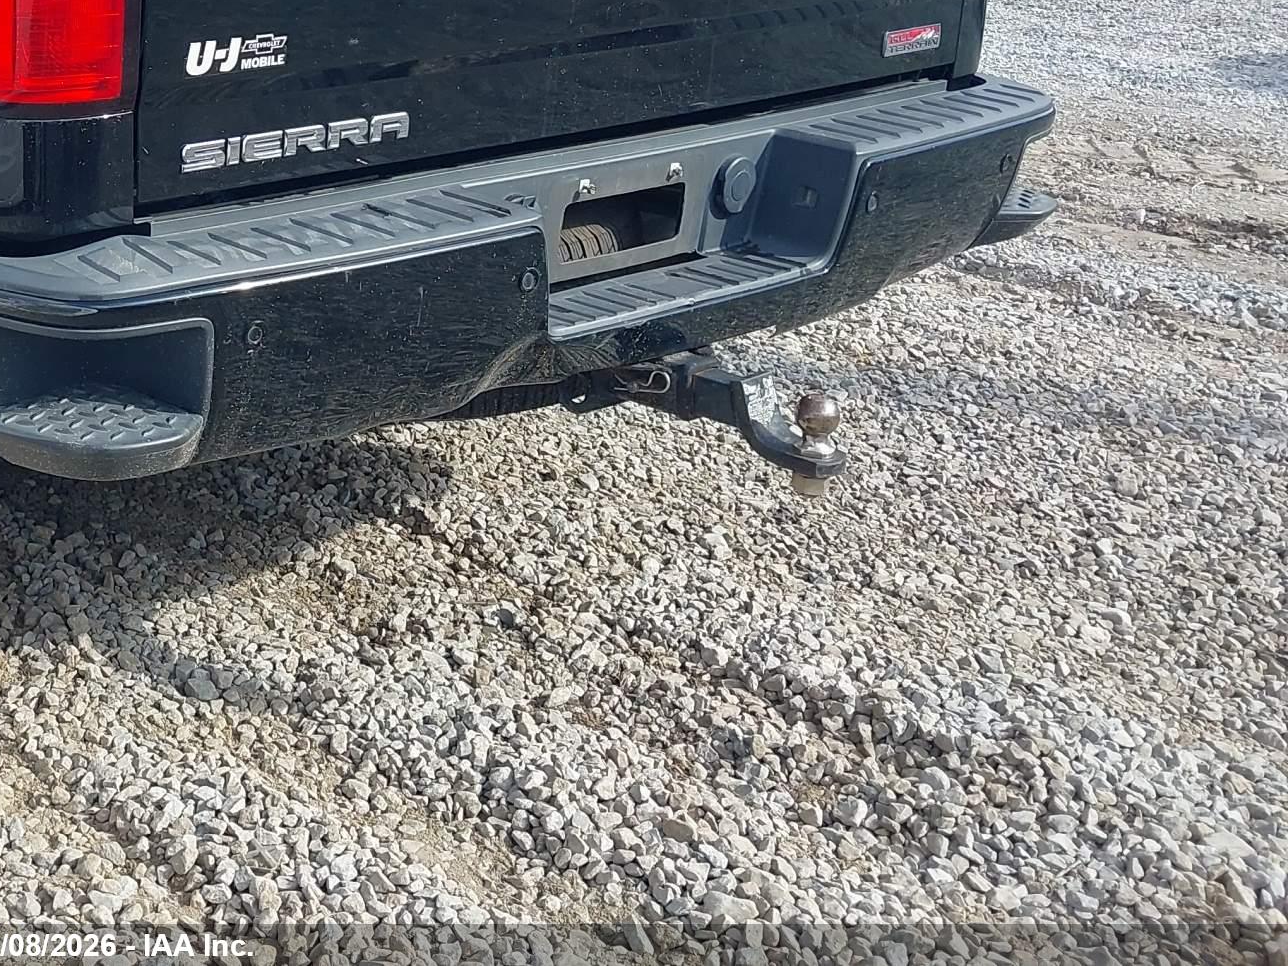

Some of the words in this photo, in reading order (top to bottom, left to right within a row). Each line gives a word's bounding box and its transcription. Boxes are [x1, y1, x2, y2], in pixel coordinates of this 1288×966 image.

[186, 37, 242, 76] U-J
[248, 40, 281, 50] CHEVROLET
[241, 54, 286, 70] MOBILE
[181, 111, 410, 174] SIERRA
